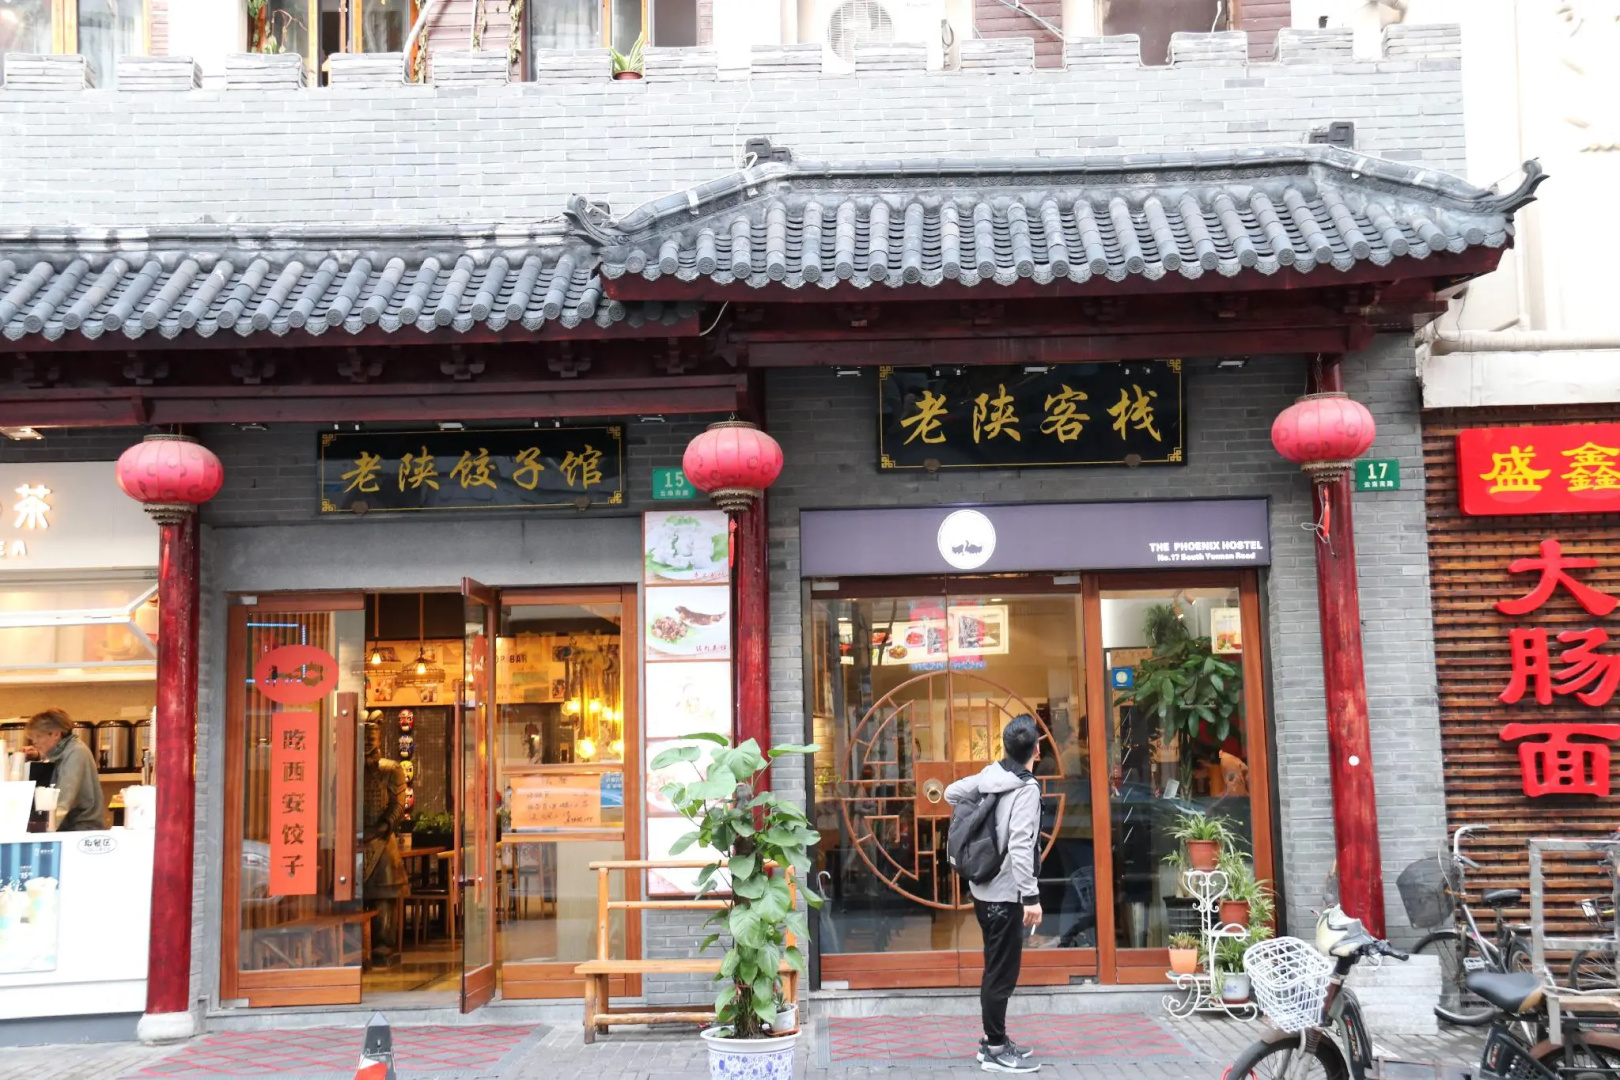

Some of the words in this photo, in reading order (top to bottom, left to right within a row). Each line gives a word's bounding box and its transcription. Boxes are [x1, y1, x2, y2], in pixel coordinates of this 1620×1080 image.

[900, 384, 1162, 445] 老陕客栈
[341, 445, 604, 493] 老陕饺子馆
[664, 471, 684, 488] 15
[1368, 463, 1388, 479] 17
[14, 483, 52, 529] 茶
[1149, 542, 1170, 553] THE
[1173, 541, 1221, 552] PHOENIX
[1222, 540, 1263, 551] HOSTEL
[1157, 553, 1179, 562] No.17
[1181, 552, 1205, 561] South
[1205, 552, 1235, 560] Yunnan
[1235, 552, 1256, 560] Road
[1493, 538, 1620, 798] 大肠面
[281, 729, 306, 878] 吃西安饺子
